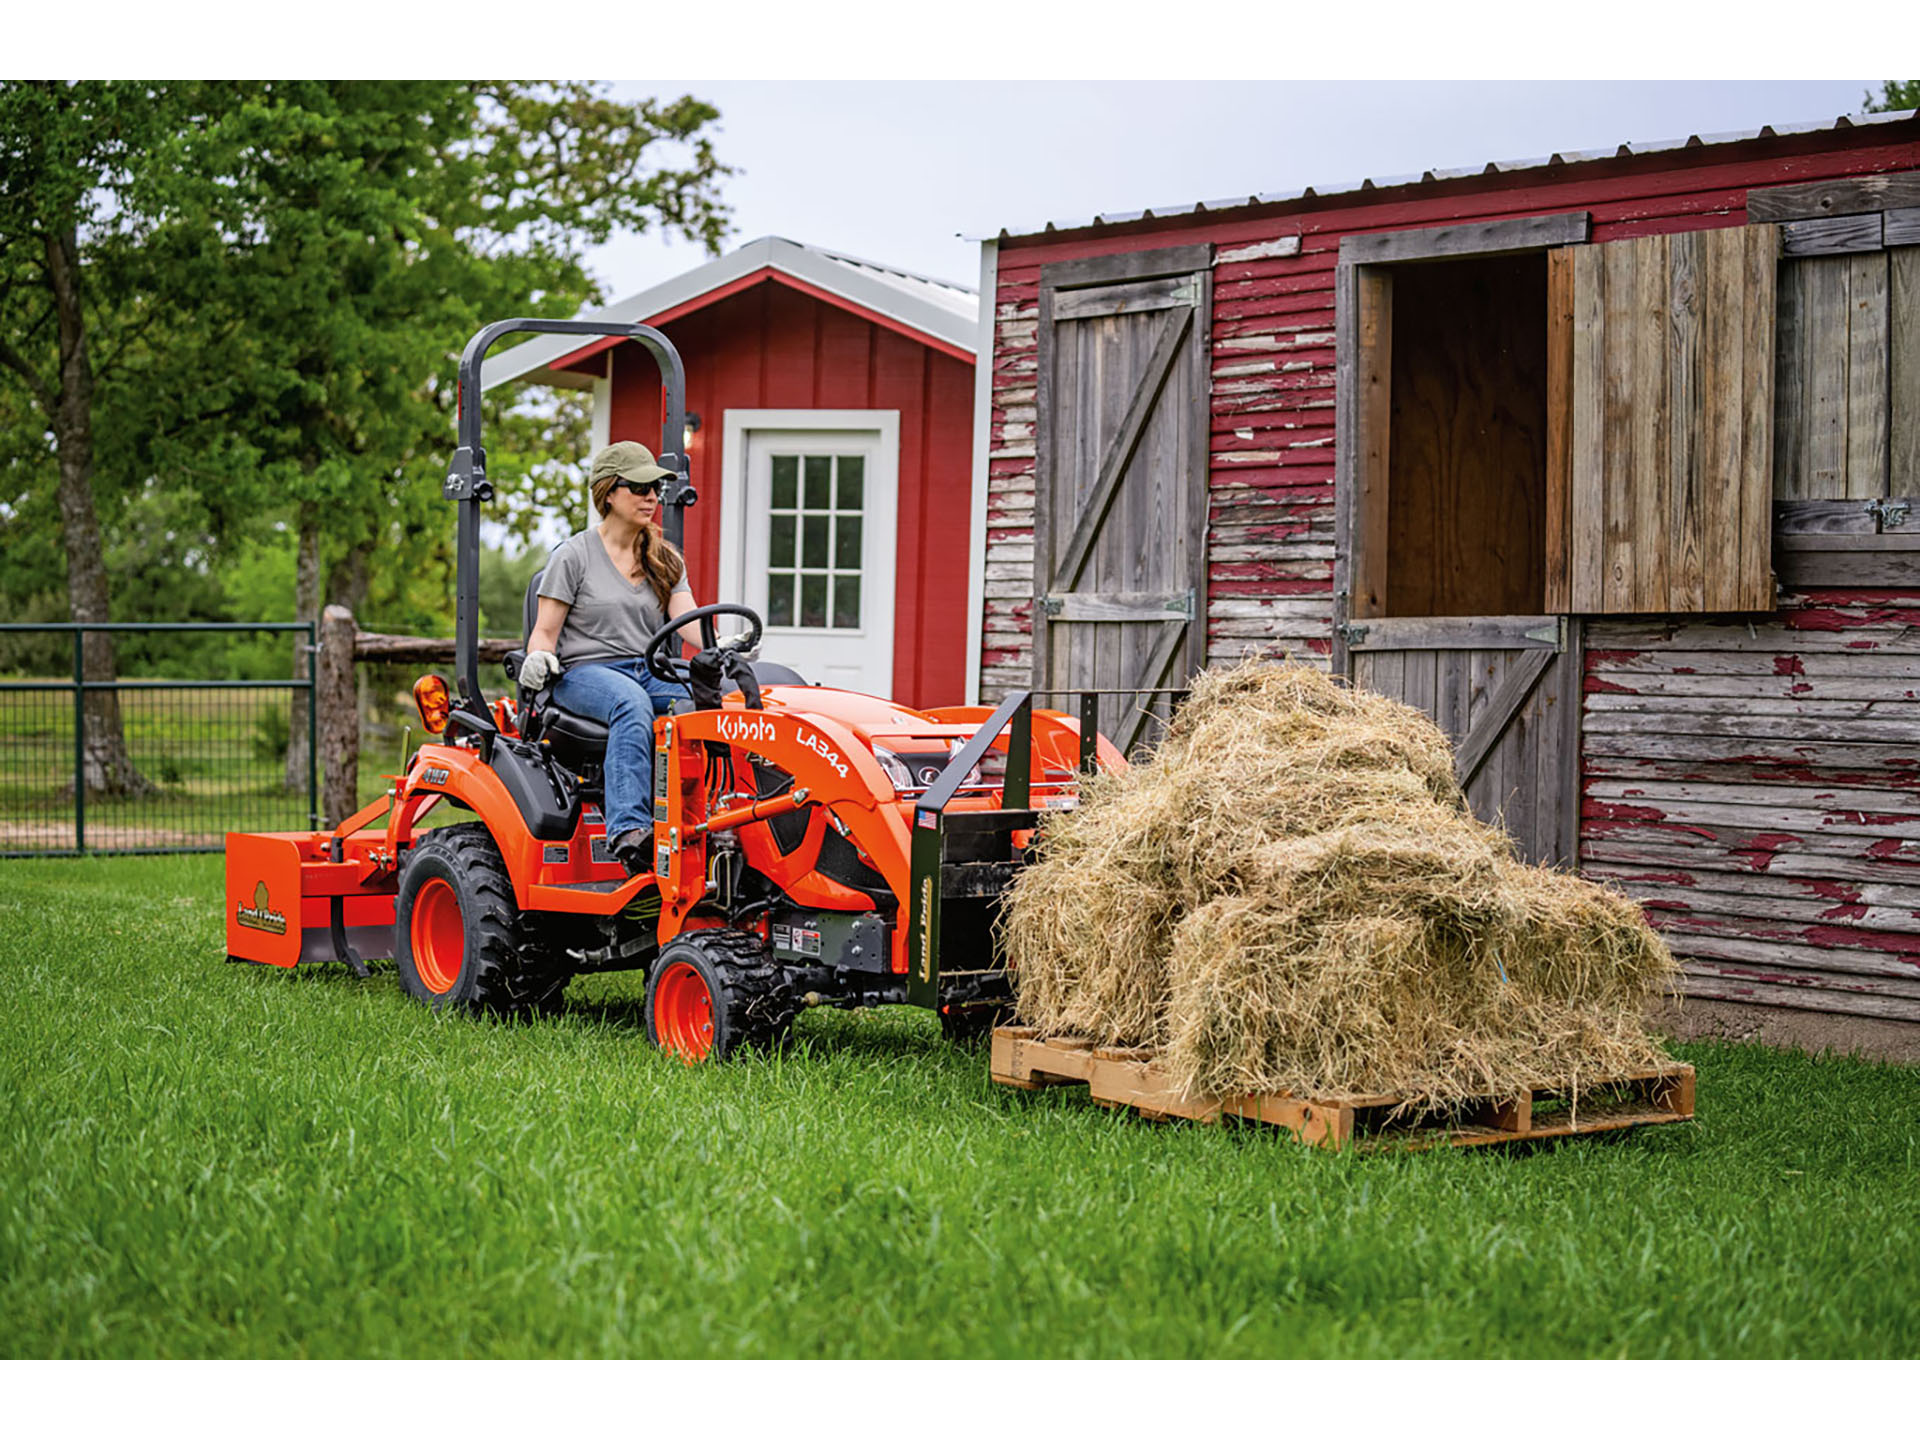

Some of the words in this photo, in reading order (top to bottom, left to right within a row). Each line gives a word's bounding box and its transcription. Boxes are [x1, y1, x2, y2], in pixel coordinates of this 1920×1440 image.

[717, 715, 776, 741] Kubota
[796, 727, 849, 778] LA344
[422, 768, 450, 785] 4WD
